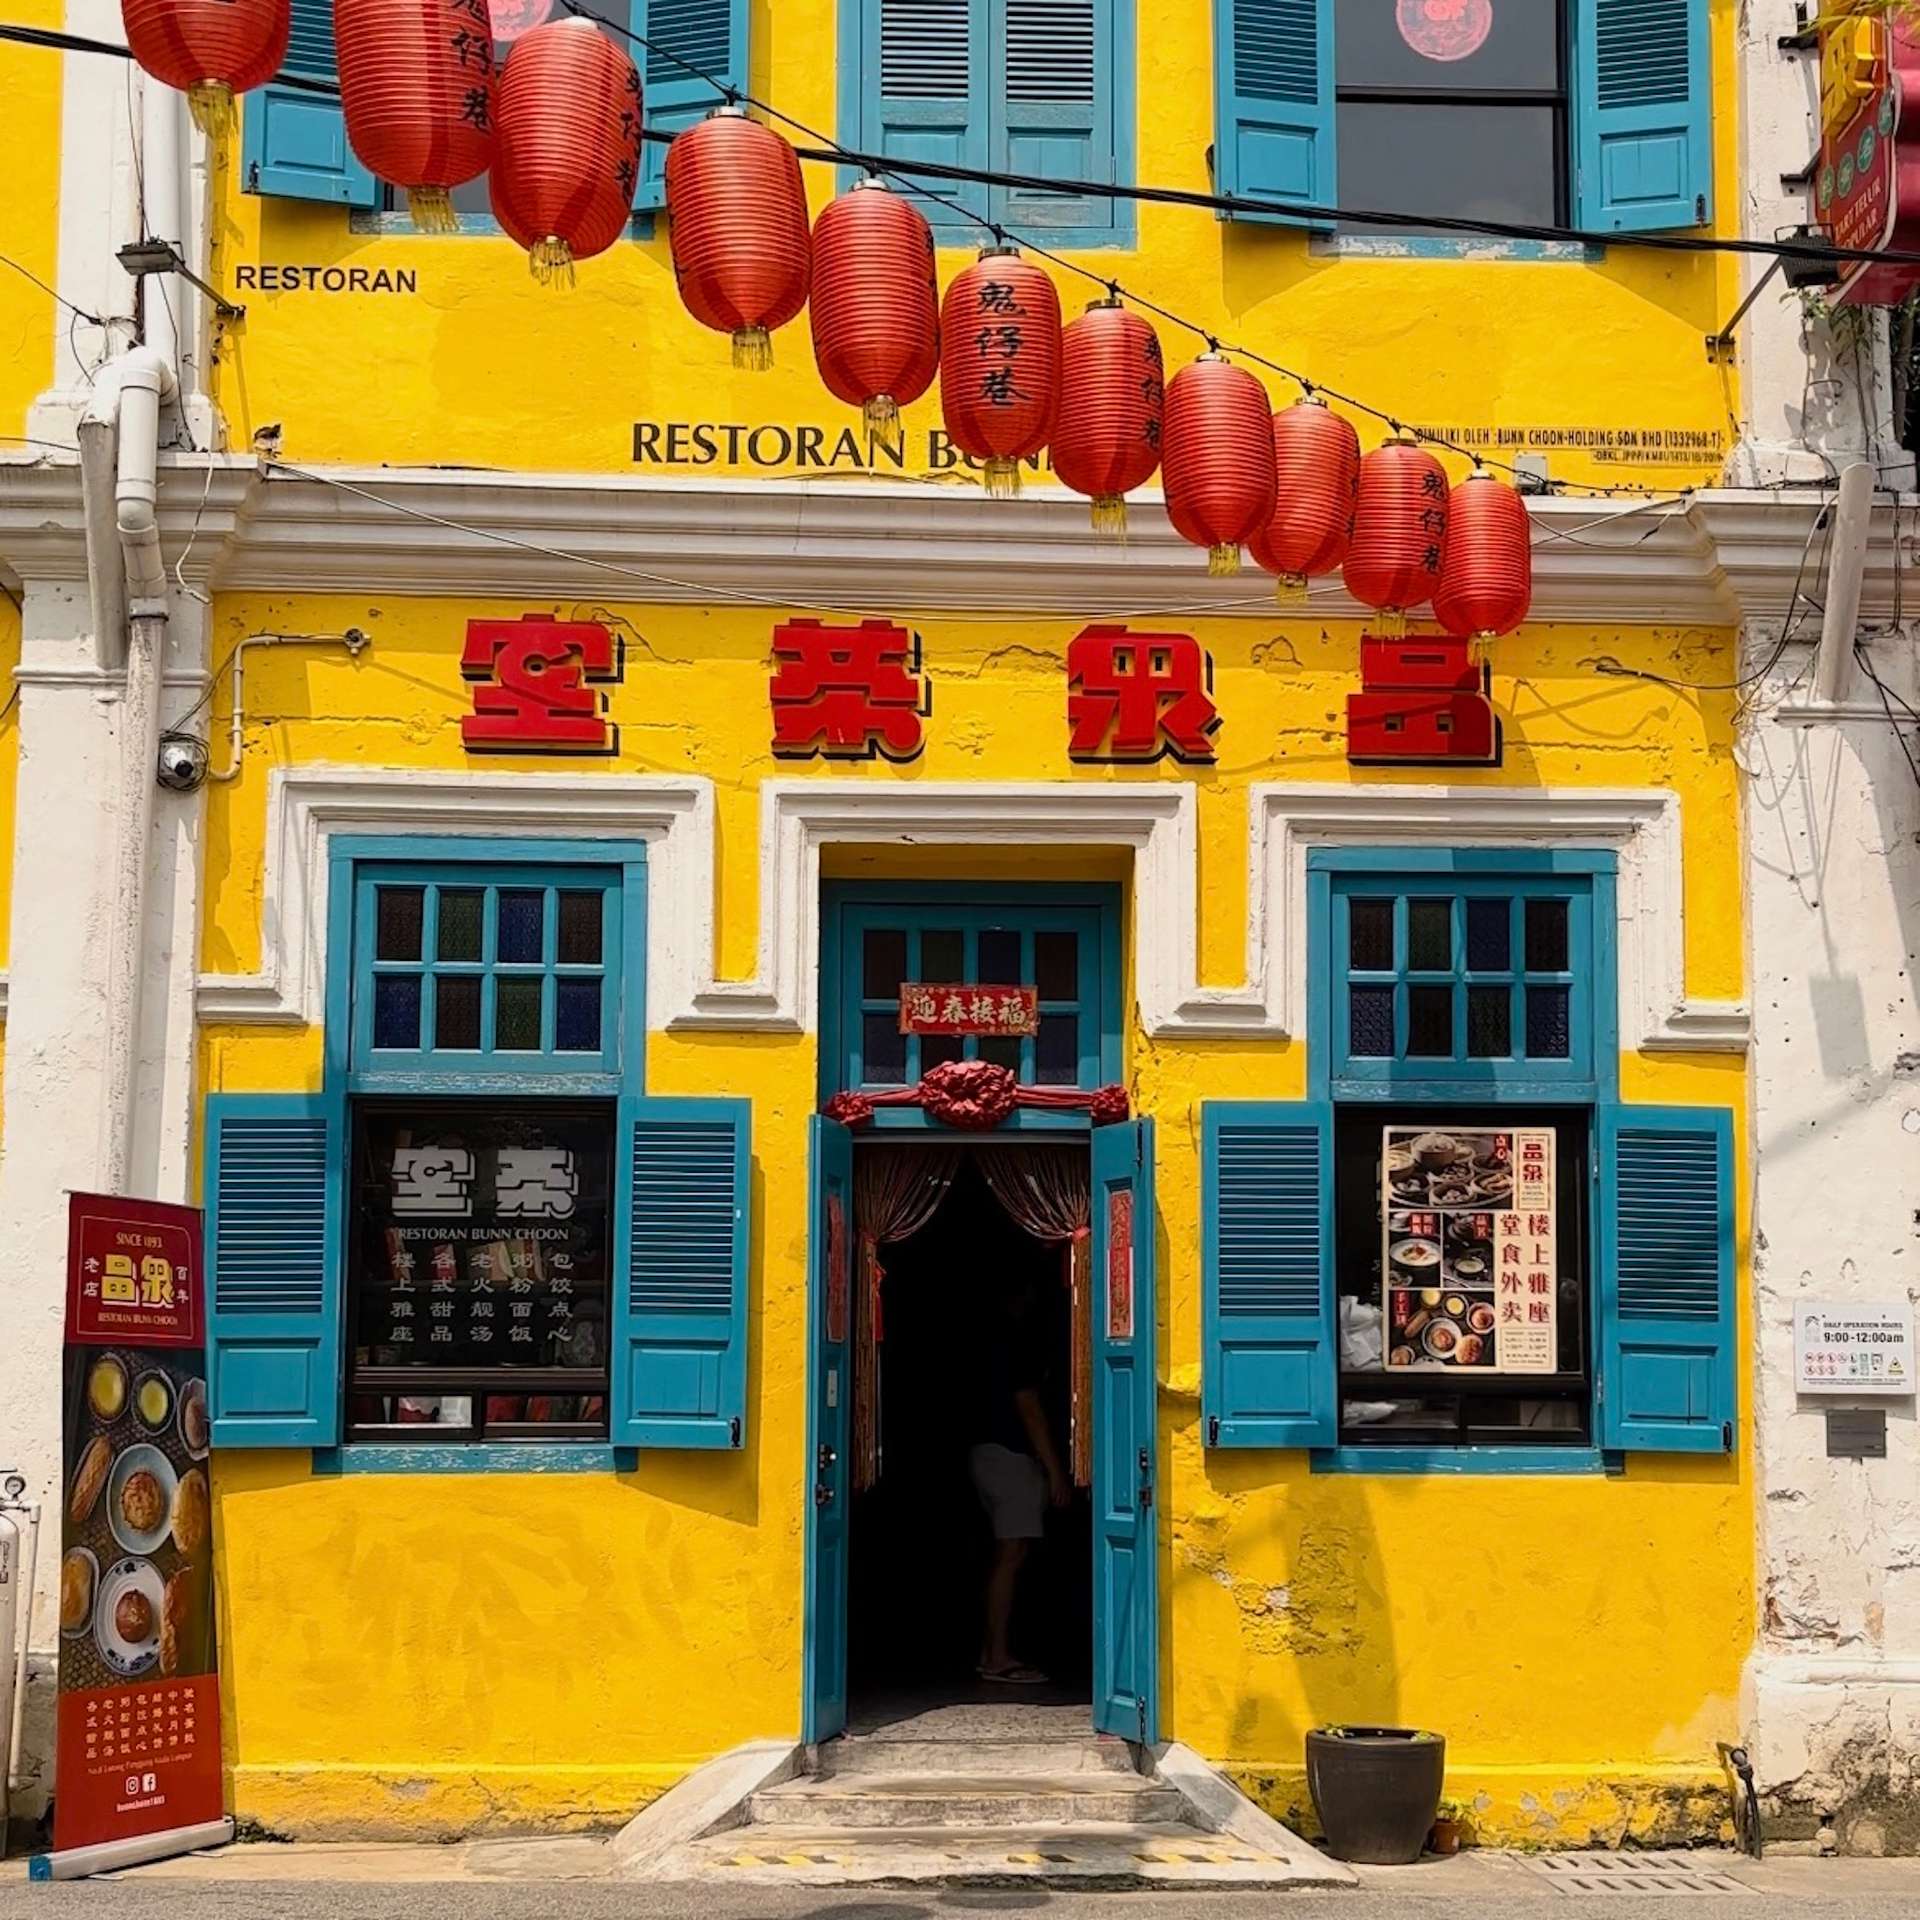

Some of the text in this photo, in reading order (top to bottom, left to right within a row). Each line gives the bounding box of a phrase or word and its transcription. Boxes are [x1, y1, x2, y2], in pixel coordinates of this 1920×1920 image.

[235, 266, 416, 293] RESTORAN
[632, 423, 905, 468] RESTORAN
[1464, 428, 1489, 444] OLEH
[1642, 431, 1662, 447] BHD
[911, 995, 1027, 1025] 迎春接福
[115, 1231, 142, 1247] SINCE
[399, 1228, 570, 1241] RESTORAN BUNN CHOON
[1500, 1213, 1523, 1323] 堂食外卖
[1528, 1213, 1550, 1323] 楼上雅座
